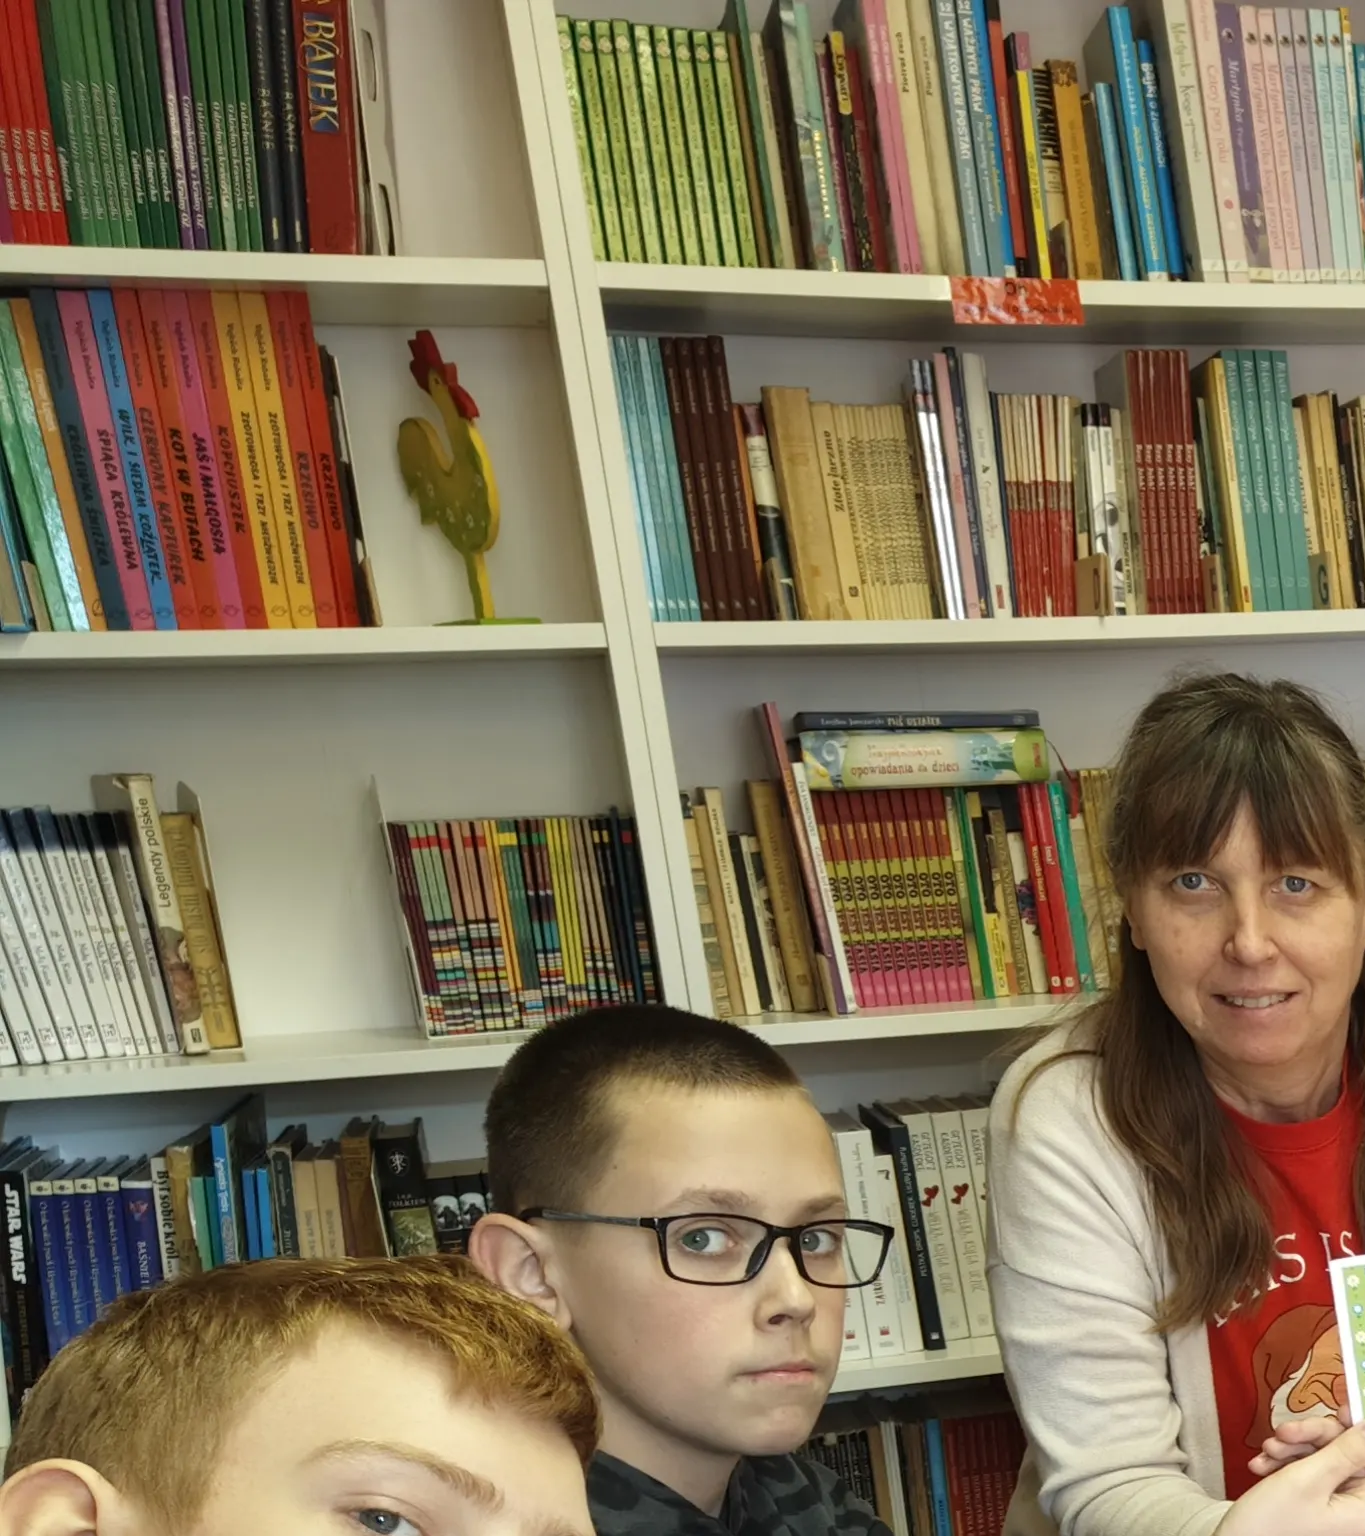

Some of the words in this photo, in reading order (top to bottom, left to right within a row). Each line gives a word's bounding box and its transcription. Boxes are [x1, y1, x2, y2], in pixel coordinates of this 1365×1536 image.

[301, 12, 342, 132] BAJEK
[169, 428, 186, 461] KOT
[177, 470, 190, 487] W
[217, 425, 245, 533] KOPCIUSZEK
[319, 453, 343, 531] KRZESIWO
[180, 493, 204, 562] BUTACH
[851, 762, 914, 778] opowiadania
[932, 761, 960, 774] dzieci
[138, 798, 157, 846] polskie
[151, 850, 171, 907] Legendy
[944, 872, 956, 897] OTO
[920, 1132, 938, 1171] GRZEGORZ
[950, 1130, 966, 1170] GRZEGORZ
[4, 1184, 22, 1233] STAR
[159, 1193, 174, 1229] sobie
[10, 1235, 26, 1284] WARS
[136, 1241, 150, 1278] BAŚNIE
